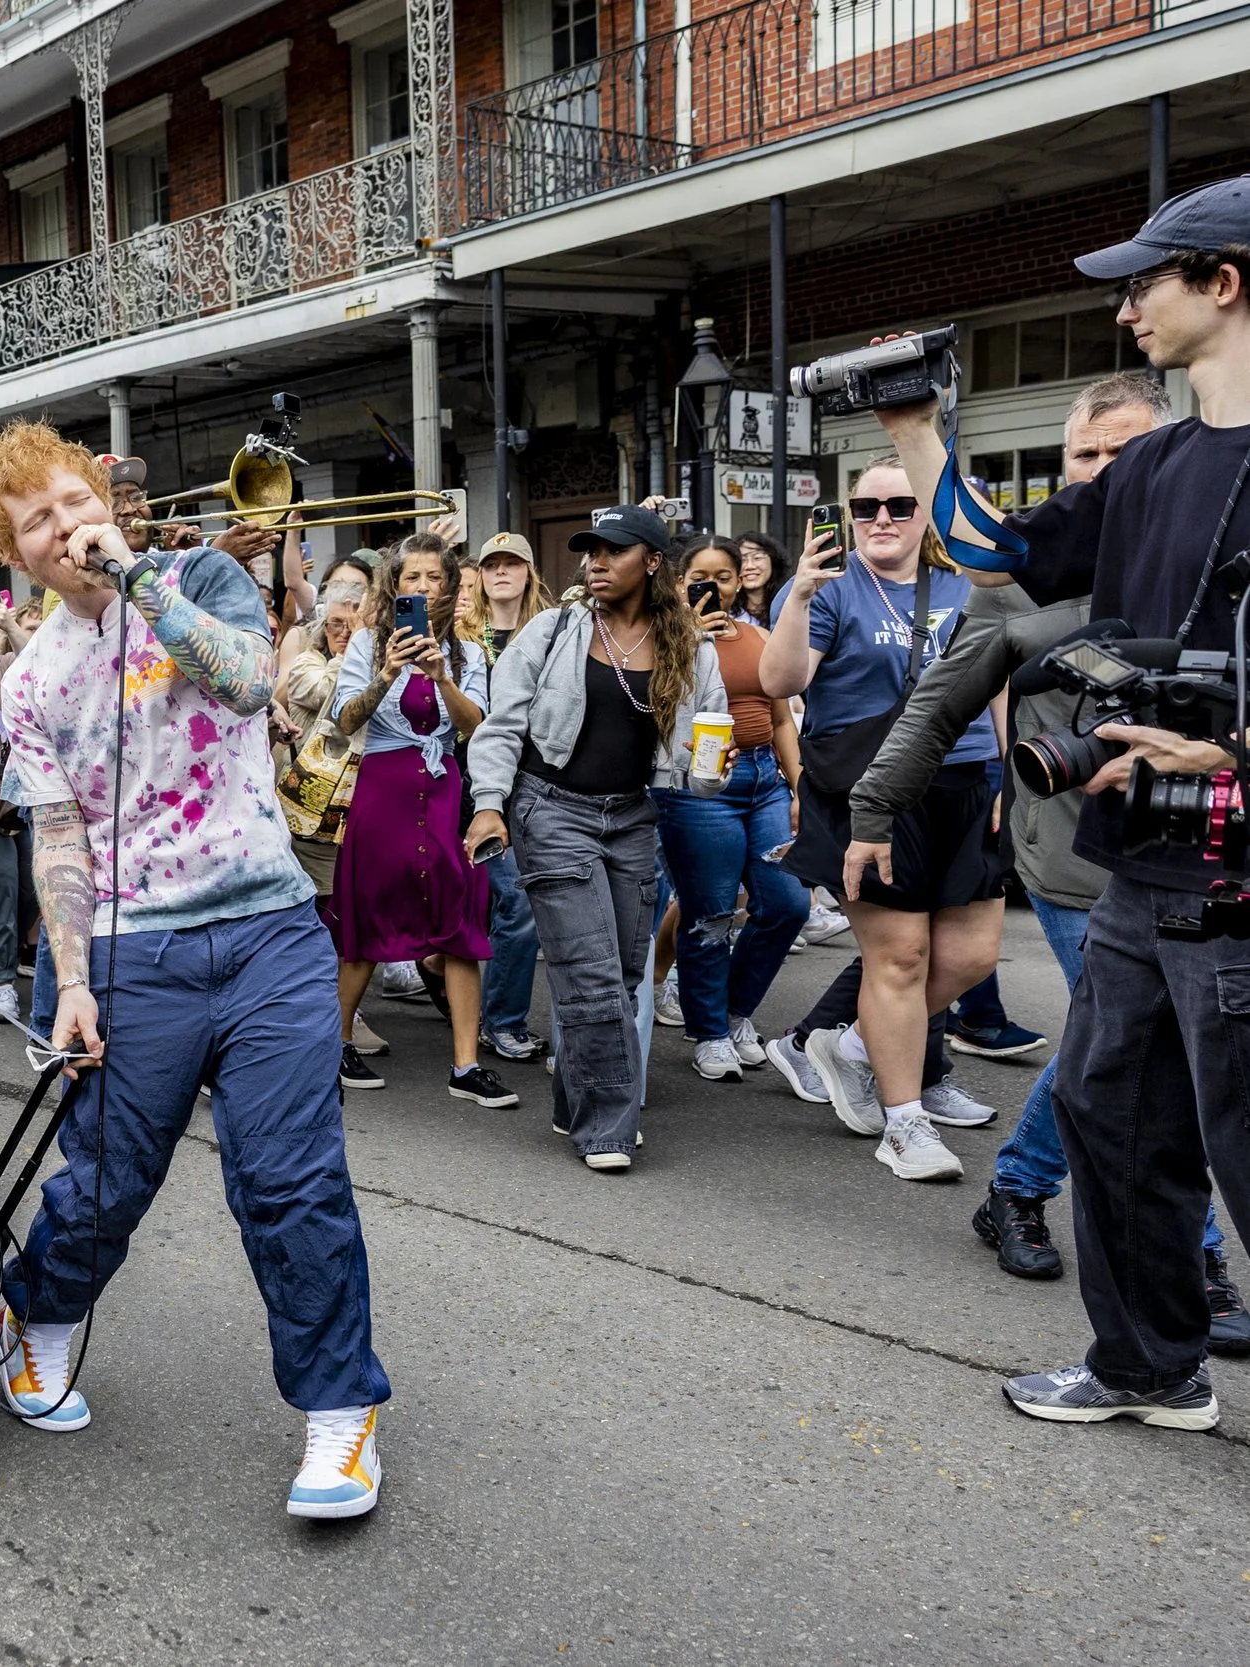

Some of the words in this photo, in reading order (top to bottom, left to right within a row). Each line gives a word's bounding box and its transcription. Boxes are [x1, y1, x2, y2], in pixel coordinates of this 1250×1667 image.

[800, 479, 813, 487] WE
[797, 489, 816, 497] SHIP
[881, 619, 890, 631] I
[874, 631, 891, 645] IT
[124, 656, 177, 699] Aries
